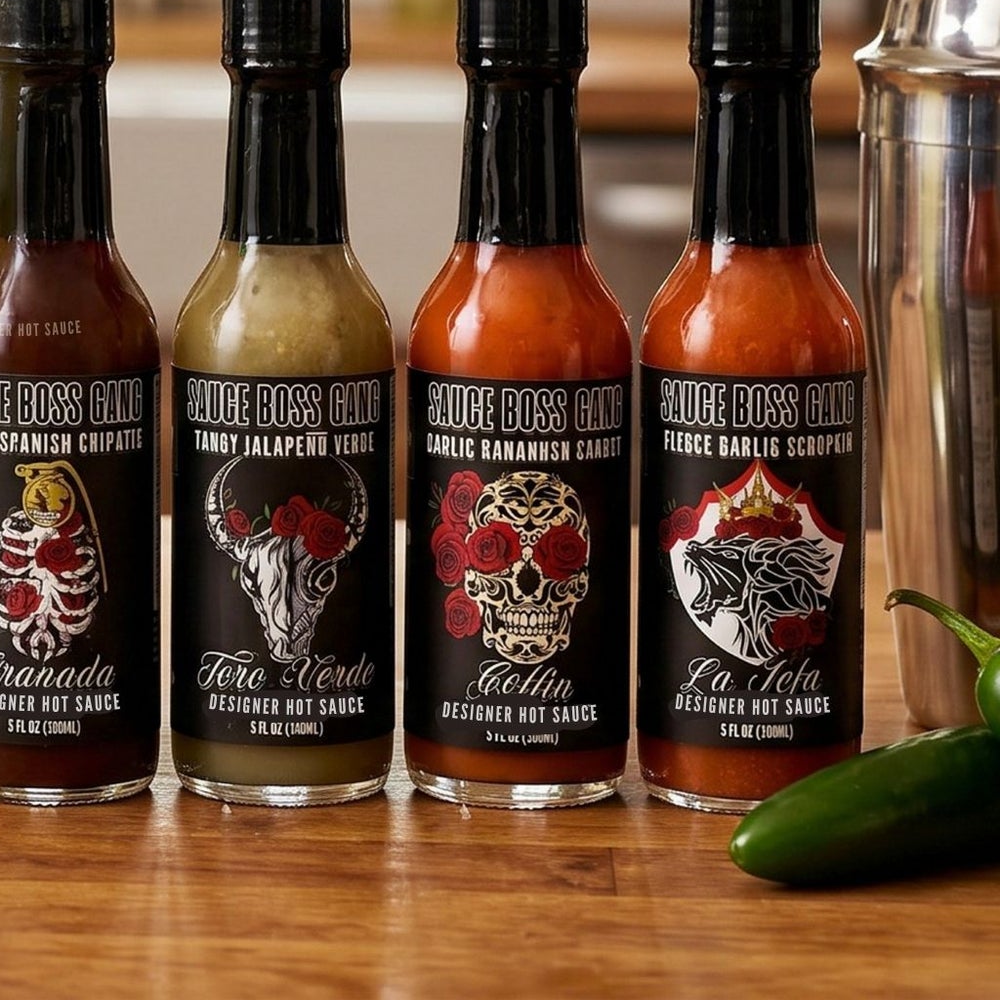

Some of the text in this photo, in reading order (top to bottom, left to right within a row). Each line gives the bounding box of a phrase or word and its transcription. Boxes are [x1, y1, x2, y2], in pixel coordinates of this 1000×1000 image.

[18, 322, 39, 337] HOT
[45, 320, 82, 336] SAUCE
[18, 381, 83, 426] BOSS
[90, 378, 143, 425] GANG
[187, 377, 380, 428] SAUCE BOSS GANG
[428, 381, 623, 433] SAUCE BOSS GANG
[661, 378, 854, 428] SAUCE BOSS GANG
[194, 429, 238, 454] TANGY
[680, 657, 736, 695] La
[42, 695, 69, 712] HOT
[75, 693, 121, 711] SAUCE
[208, 693, 365, 716] DESIGNER HOT SAUCE
[442, 701, 598, 723] DESIGNER HOT SAUCE
[675, 693, 831, 716] DESIGNER HOT SAUCE
[16, 719, 27, 734] FL
[29, 719, 41, 734] OZ
[258, 721, 270, 735] FL
[271, 722, 283, 735] OZ
[728, 723, 740, 738] FL
[741, 724, 753, 738] OZ
